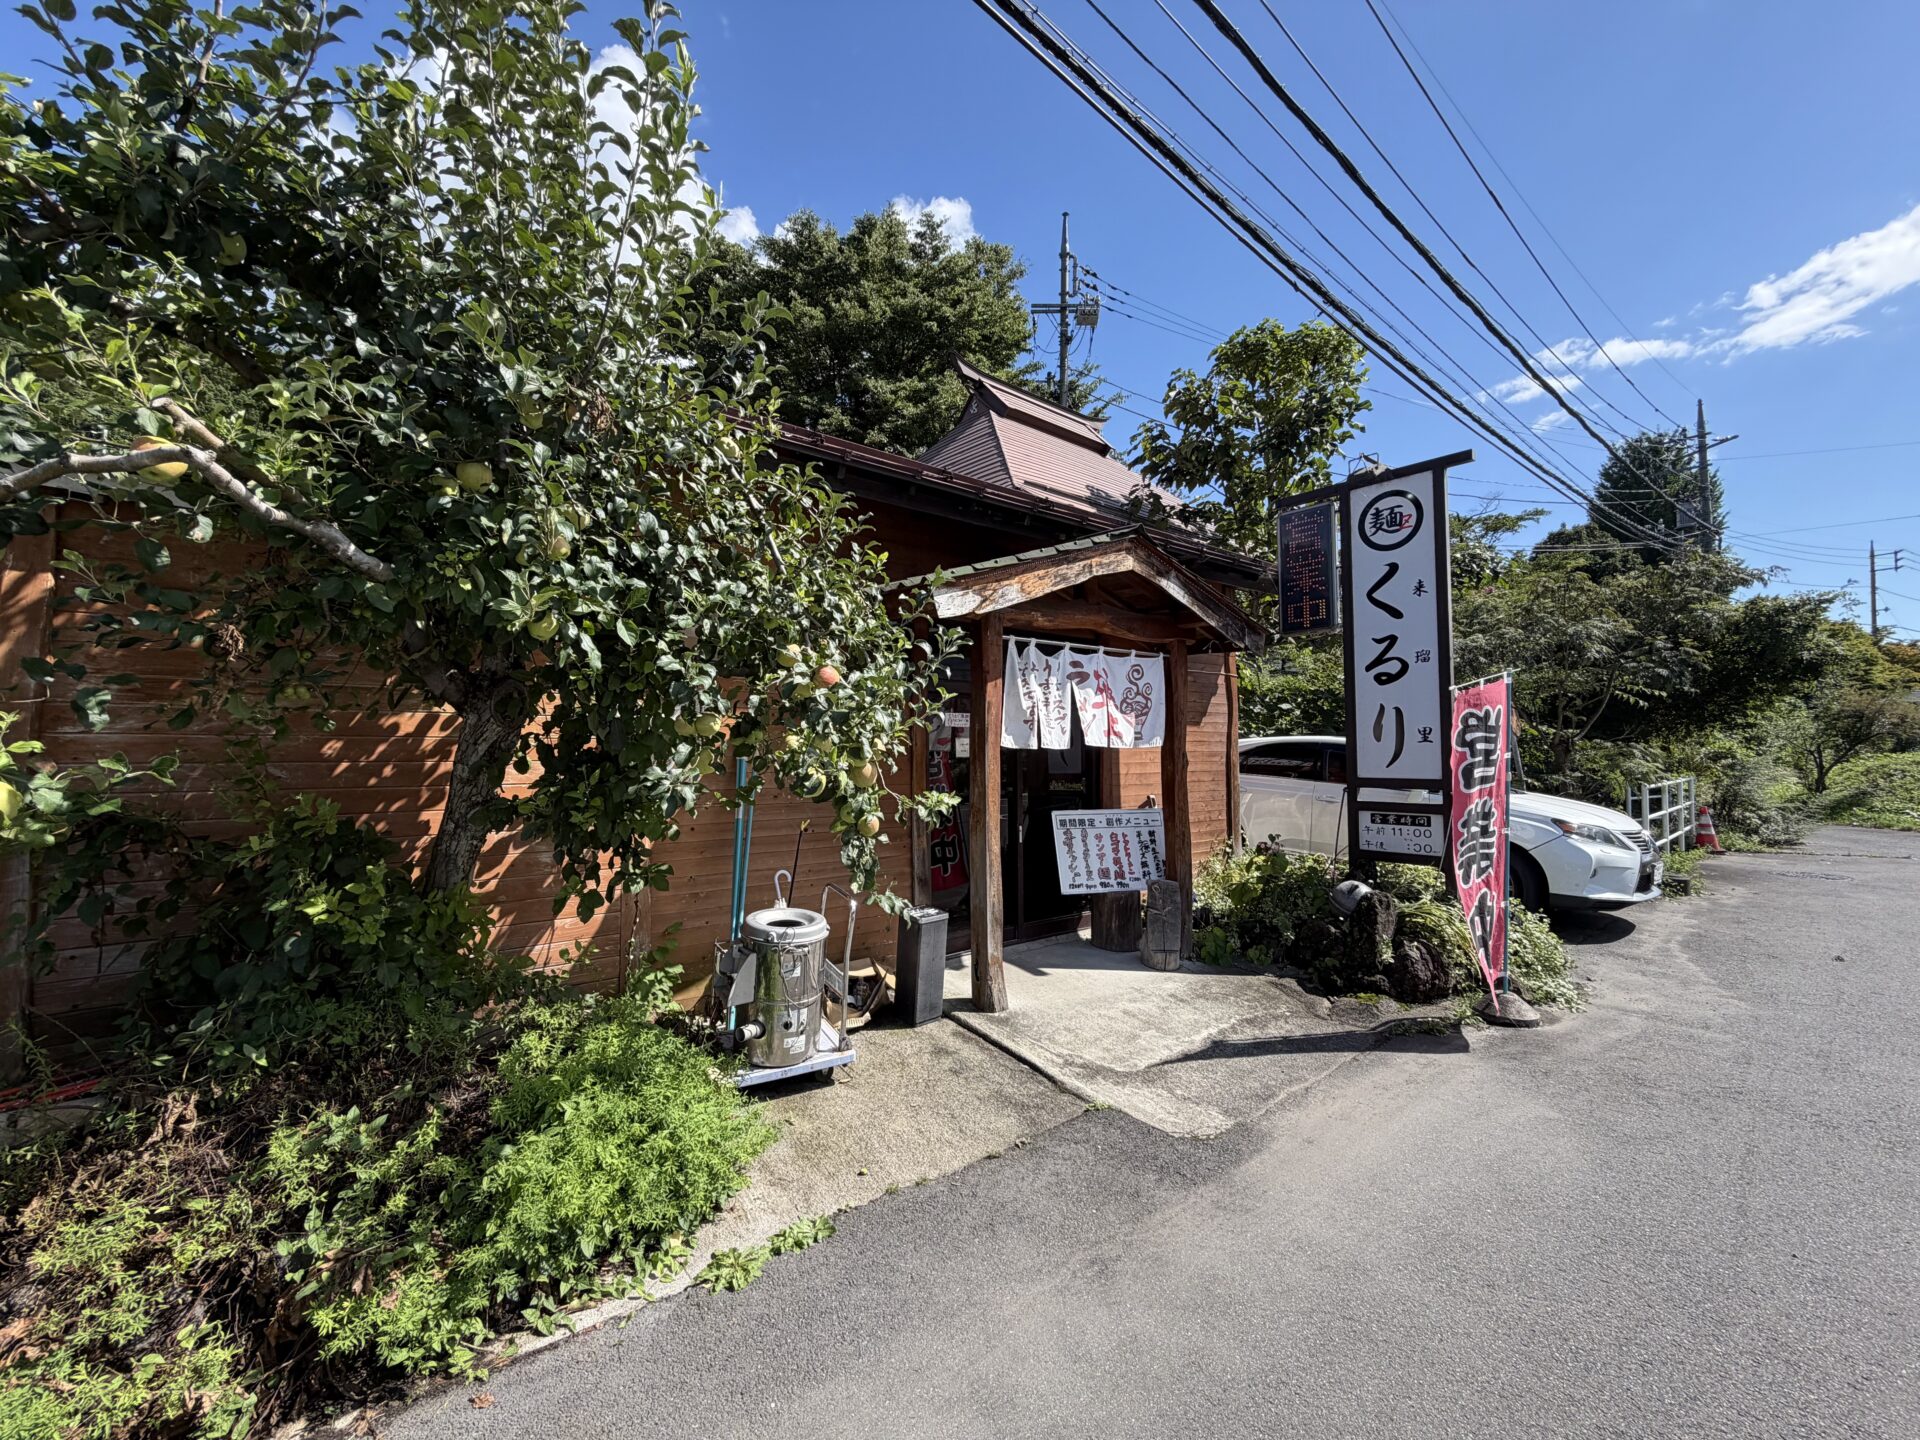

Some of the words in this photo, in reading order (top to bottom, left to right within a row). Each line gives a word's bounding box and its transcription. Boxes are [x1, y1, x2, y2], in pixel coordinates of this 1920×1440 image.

[1285, 510, 1327, 629] 営業中
[1364, 561, 1411, 769] くるり
[1362, 825, 1386, 836] 午前
[1390, 827, 1433, 839] 11:00
[1362, 840, 1389, 851] 午後
[1371, 814, 1429, 826] 営業時間
[1453, 704, 1503, 973] 営業中
